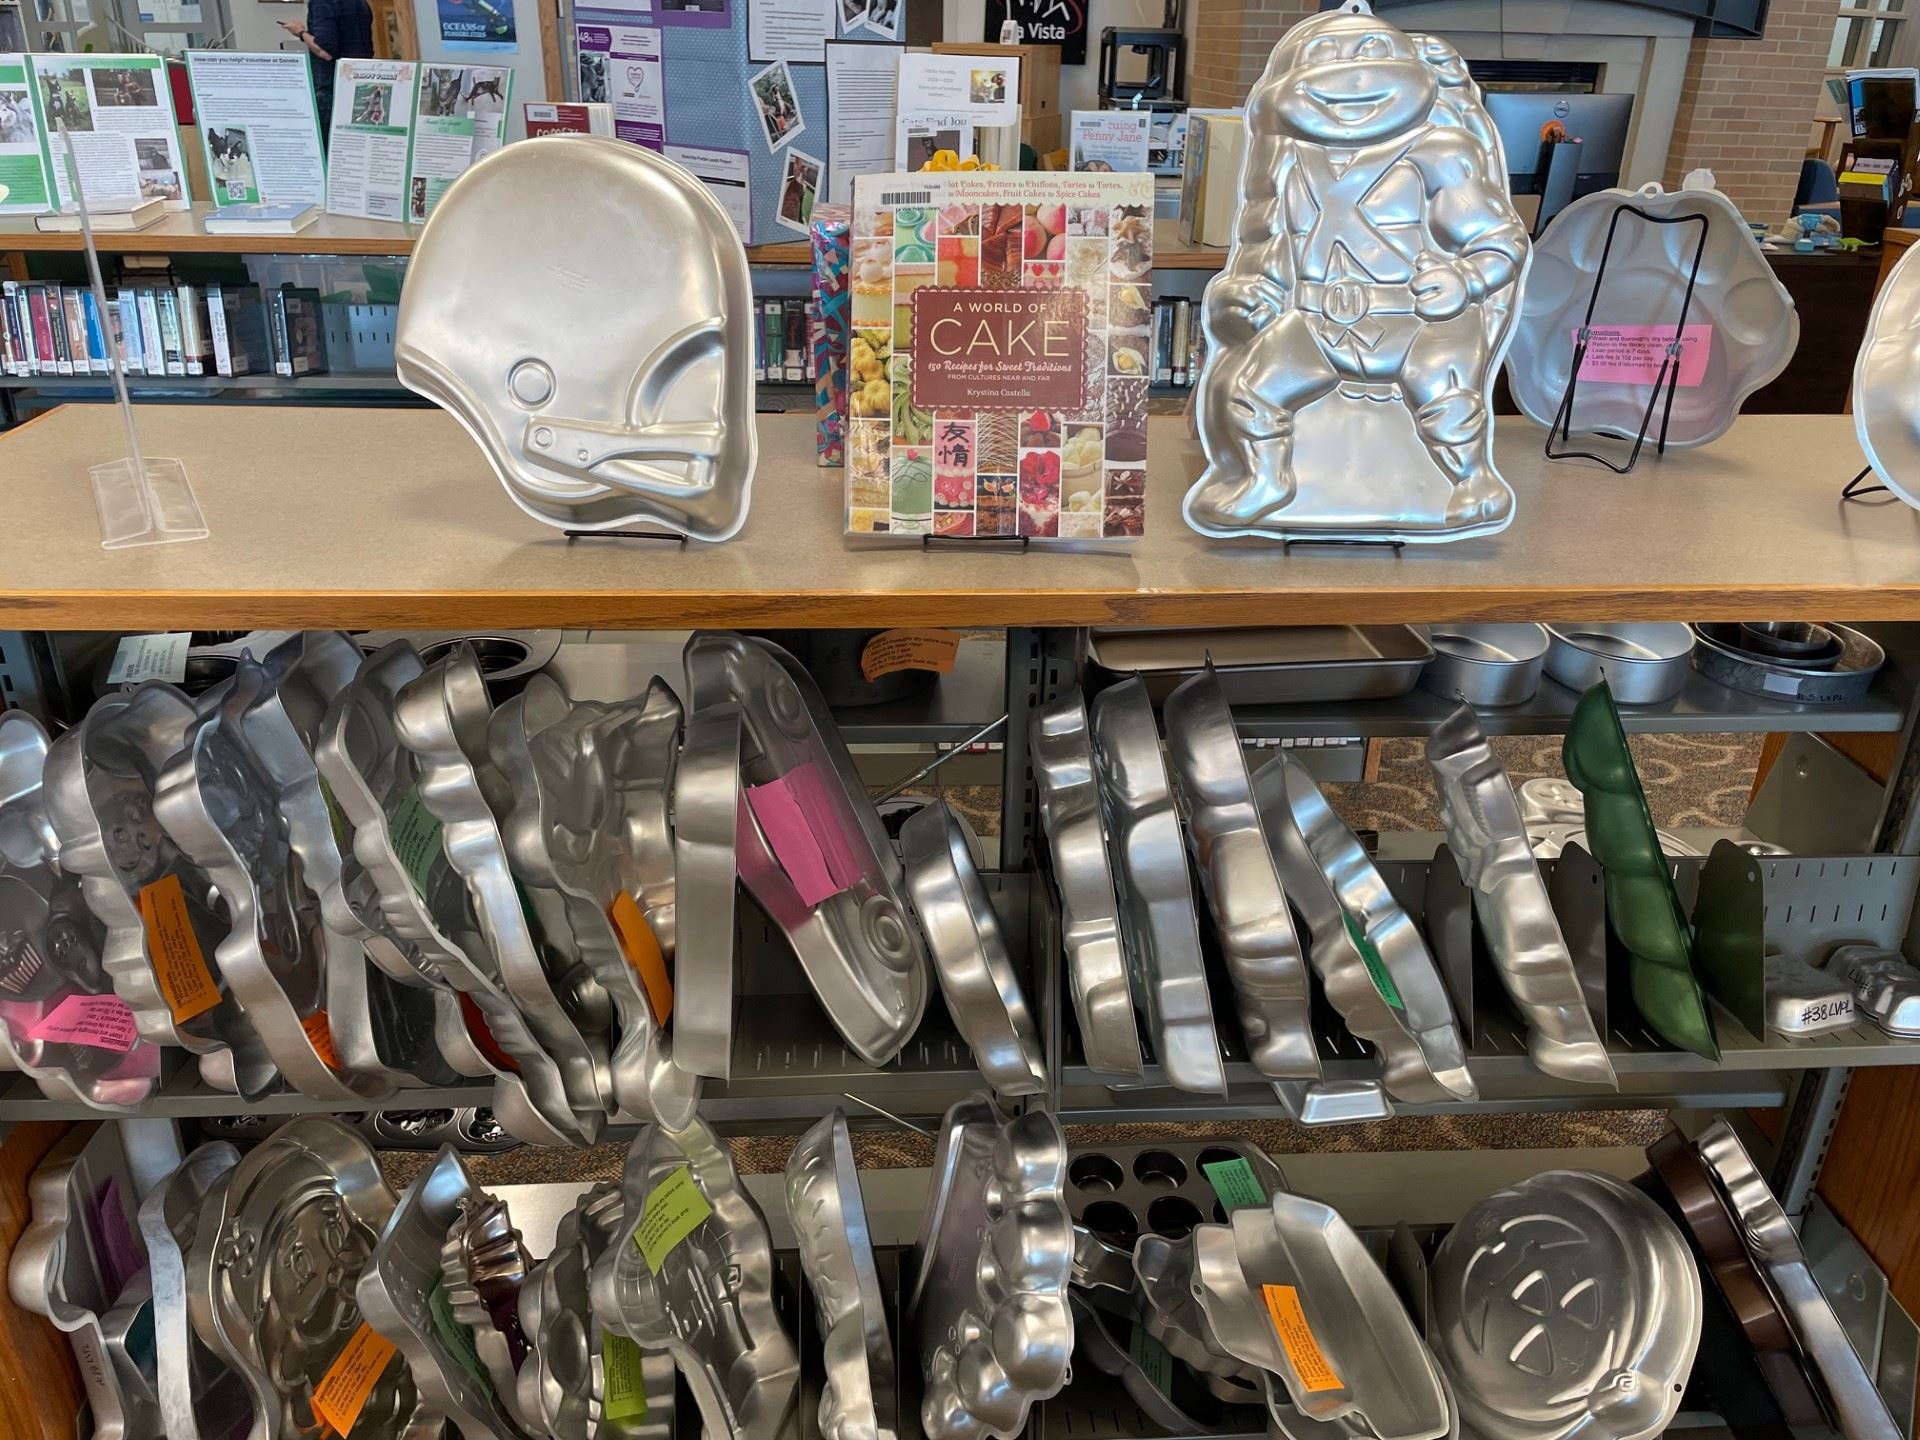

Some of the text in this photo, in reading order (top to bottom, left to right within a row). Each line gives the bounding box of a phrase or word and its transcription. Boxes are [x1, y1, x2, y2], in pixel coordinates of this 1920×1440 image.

[1028, 23, 1065, 39] Vista
[1083, 129, 1142, 143] Penny Jane
[960, 180, 985, 188] Cakes,
[988, 180, 1017, 188] Fritters
[1025, 180, 1061, 189] Chiffons,
[955, 189, 1002, 198] Mooncakes,
[1003, 189, 1021, 198] Fruit
[1023, 190, 1045, 198] Cakes
[1056, 190, 1076, 199] Spice
[1078, 190, 1100, 198] Cakes
[1330, 284, 1363, 316] M
[953, 302, 1047, 313] A WORLD OF
[930, 318, 1070, 356] CAKE
[928, 360, 1071, 373] 150 Recipes for Sweet Traditions
[967, 388, 1030, 397] Krystina Castella
